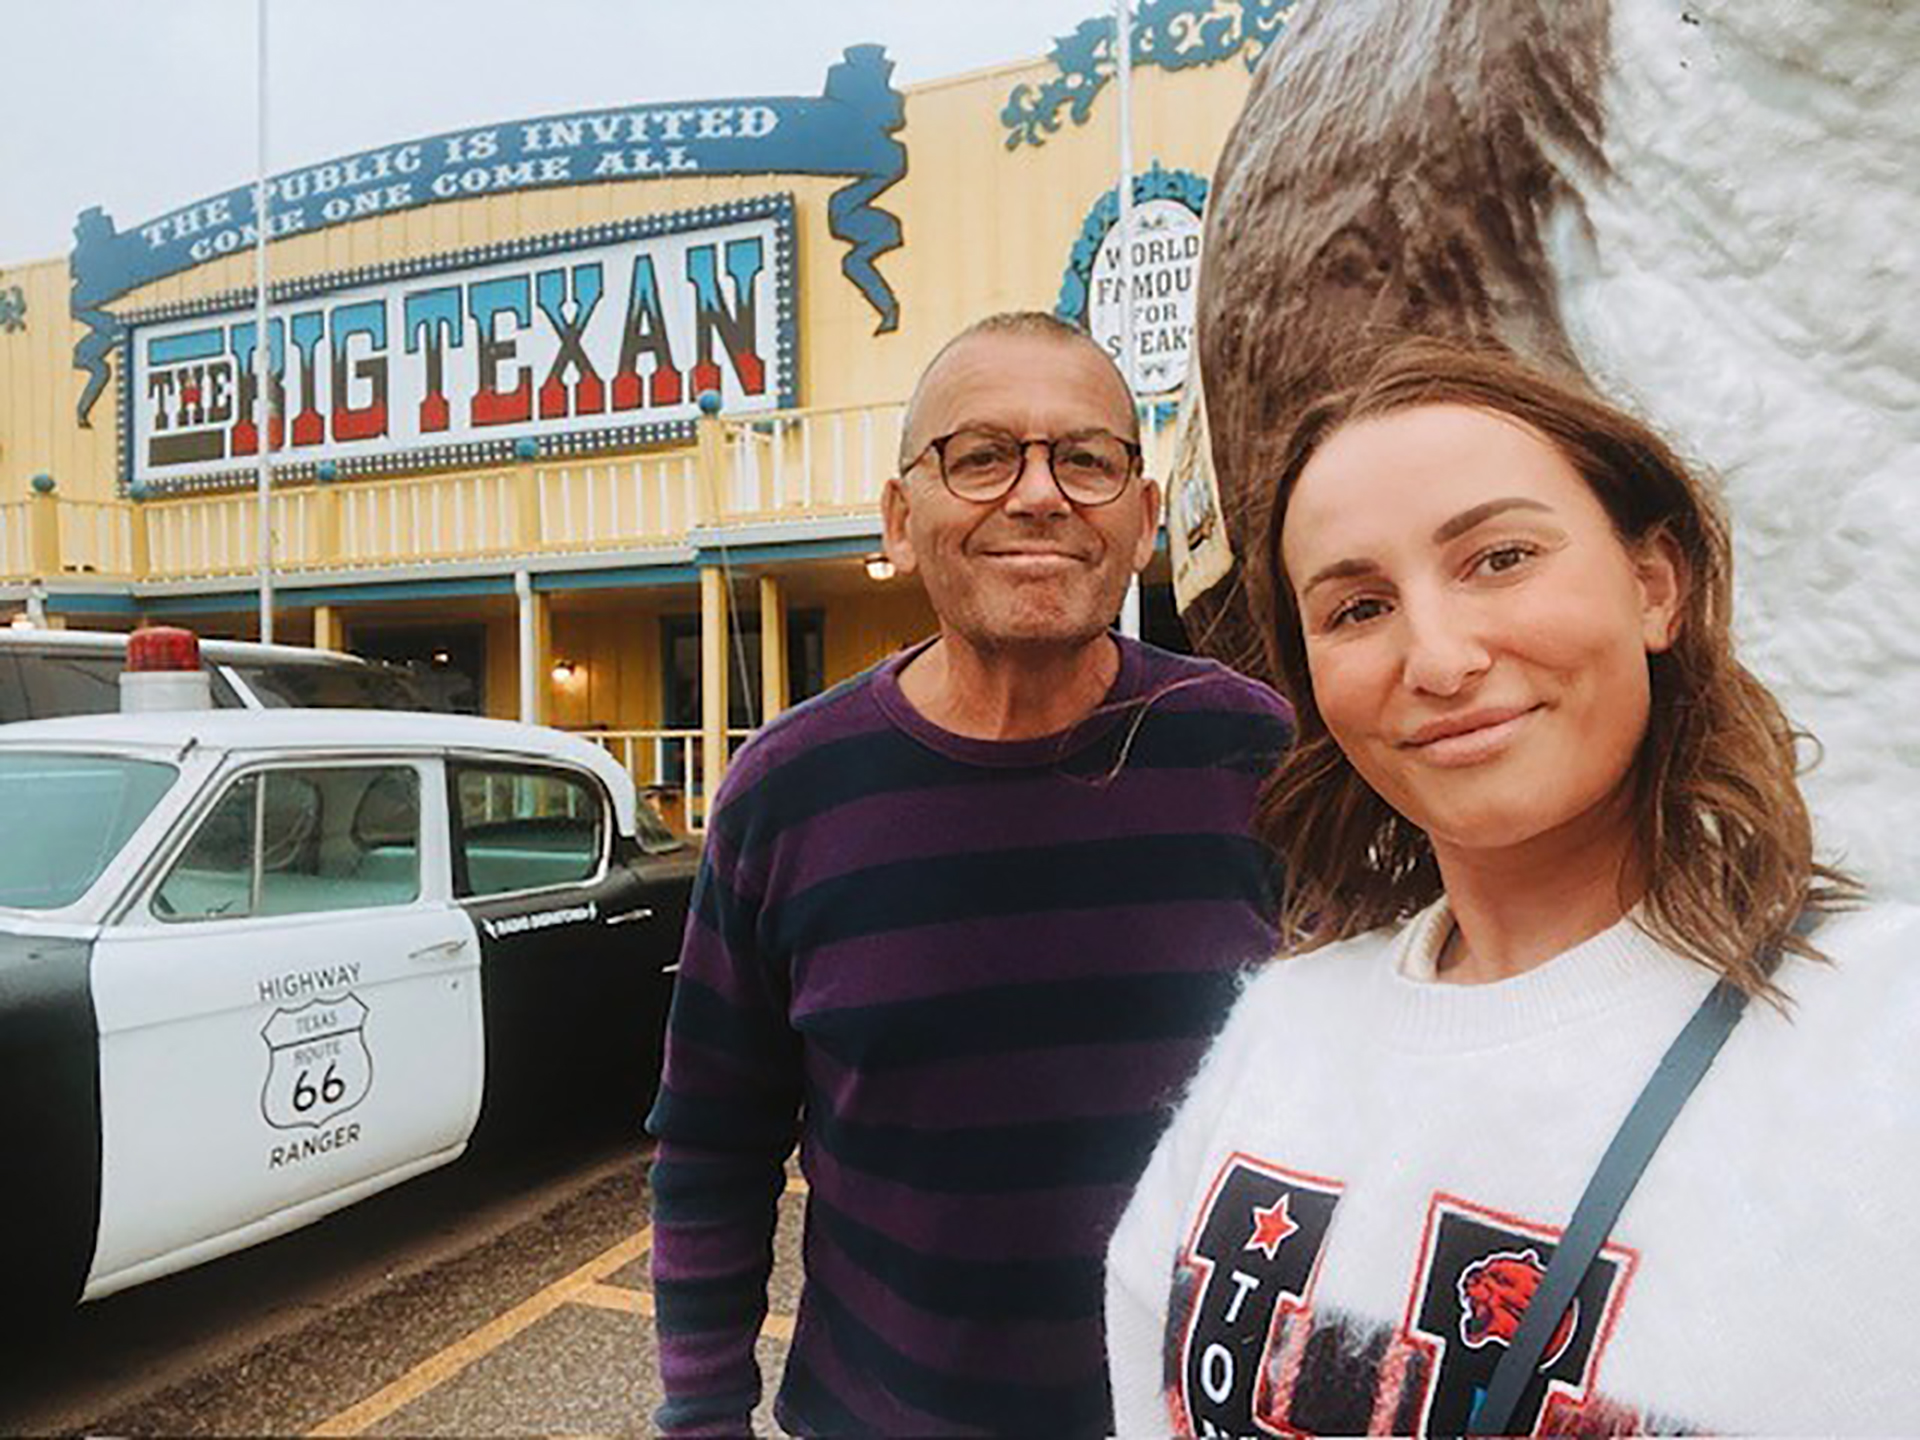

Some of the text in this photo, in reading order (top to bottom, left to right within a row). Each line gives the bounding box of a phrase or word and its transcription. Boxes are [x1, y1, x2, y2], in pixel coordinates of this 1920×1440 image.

[141, 105, 779, 249] THE PUBLIC IS INVITED
[189, 146, 699, 262] COME ONE COME ALL
[1096, 266, 1192, 306] FAMOU
[147, 235, 766, 457] THE BIG TEXAN
[1106, 325, 1194, 360] SEAK
[258, 962, 361, 1001] HIGHWAY
[296, 1010, 338, 1035] TEXAS
[293, 1040, 342, 1067] ROUTE
[292, 1058, 346, 1113] 66
[268, 1123, 361, 1170] RANGER
